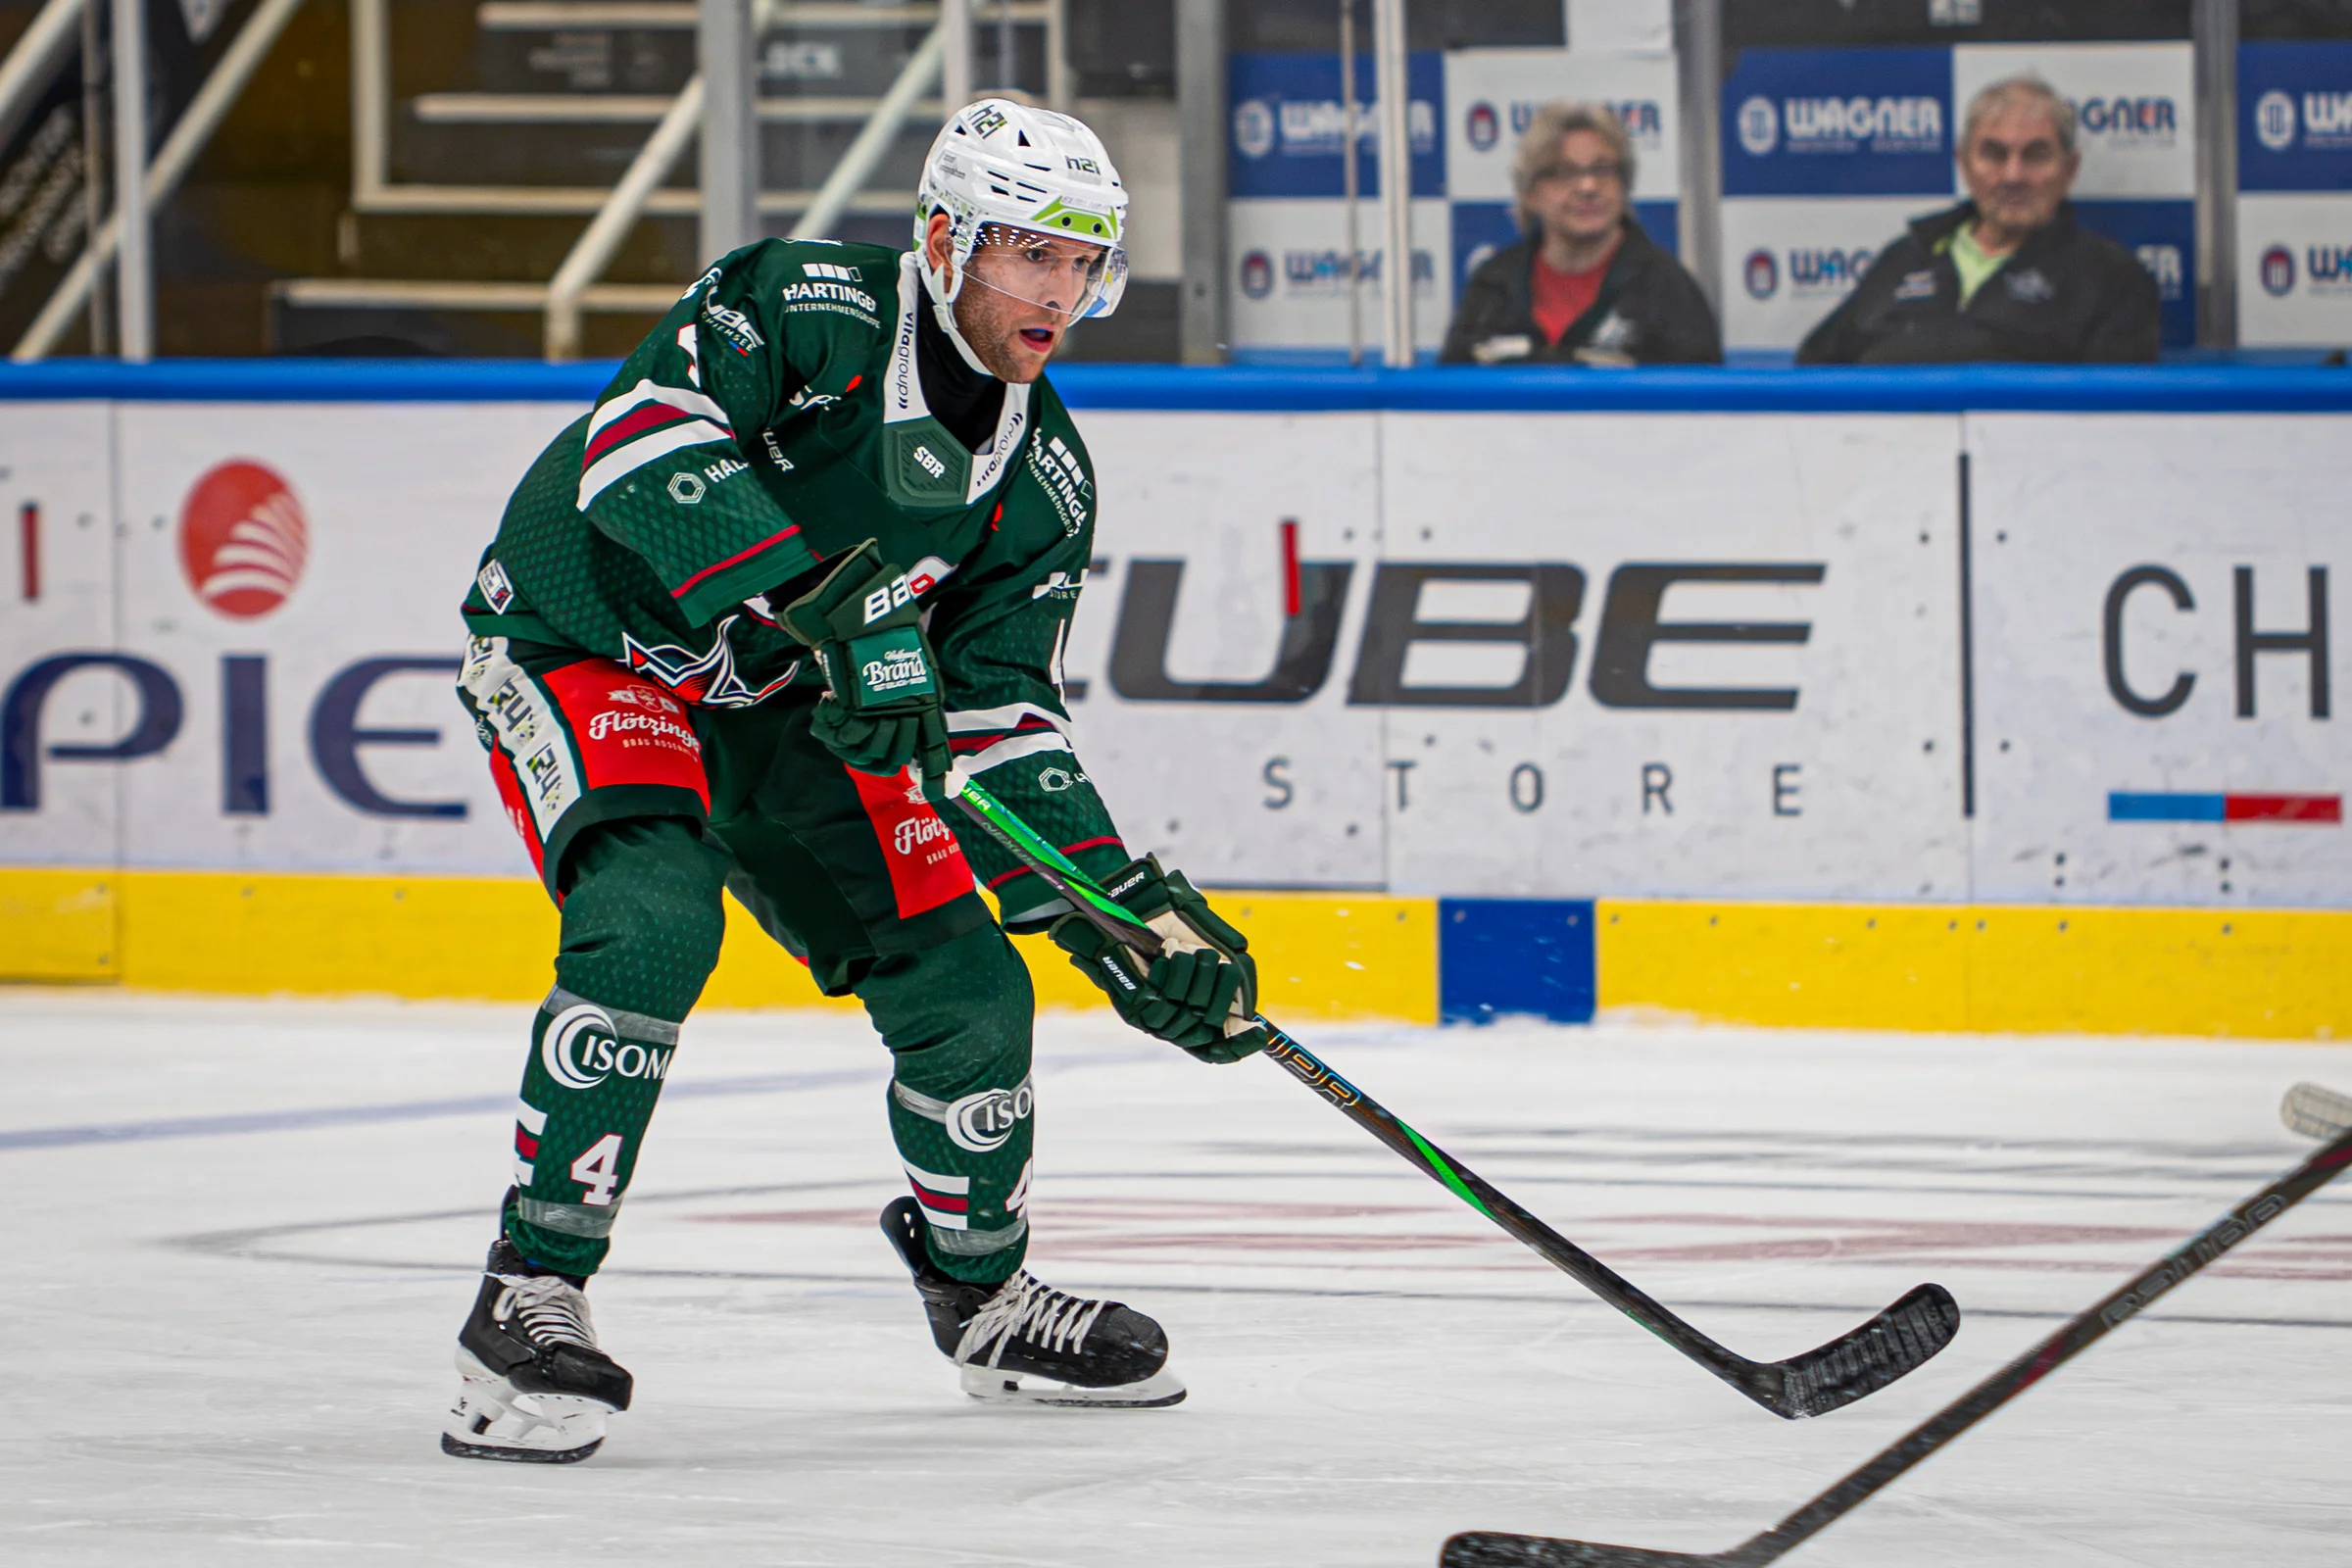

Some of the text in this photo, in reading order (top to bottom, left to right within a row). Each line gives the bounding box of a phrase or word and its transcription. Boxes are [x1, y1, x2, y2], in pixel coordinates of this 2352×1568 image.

[1786, 96, 1941, 138] WAGNER
[913, 446, 946, 479] SBR
[1070, 557, 1829, 711] UBE
[2103, 563, 2331, 720] CH
[862, 648, 927, 686] Brand
[1261, 755, 1804, 816] STORE
[1108, 871, 1145, 899] AUER
[1102, 956, 1137, 991] BAUER
[569, 1132, 624, 1206] 4
